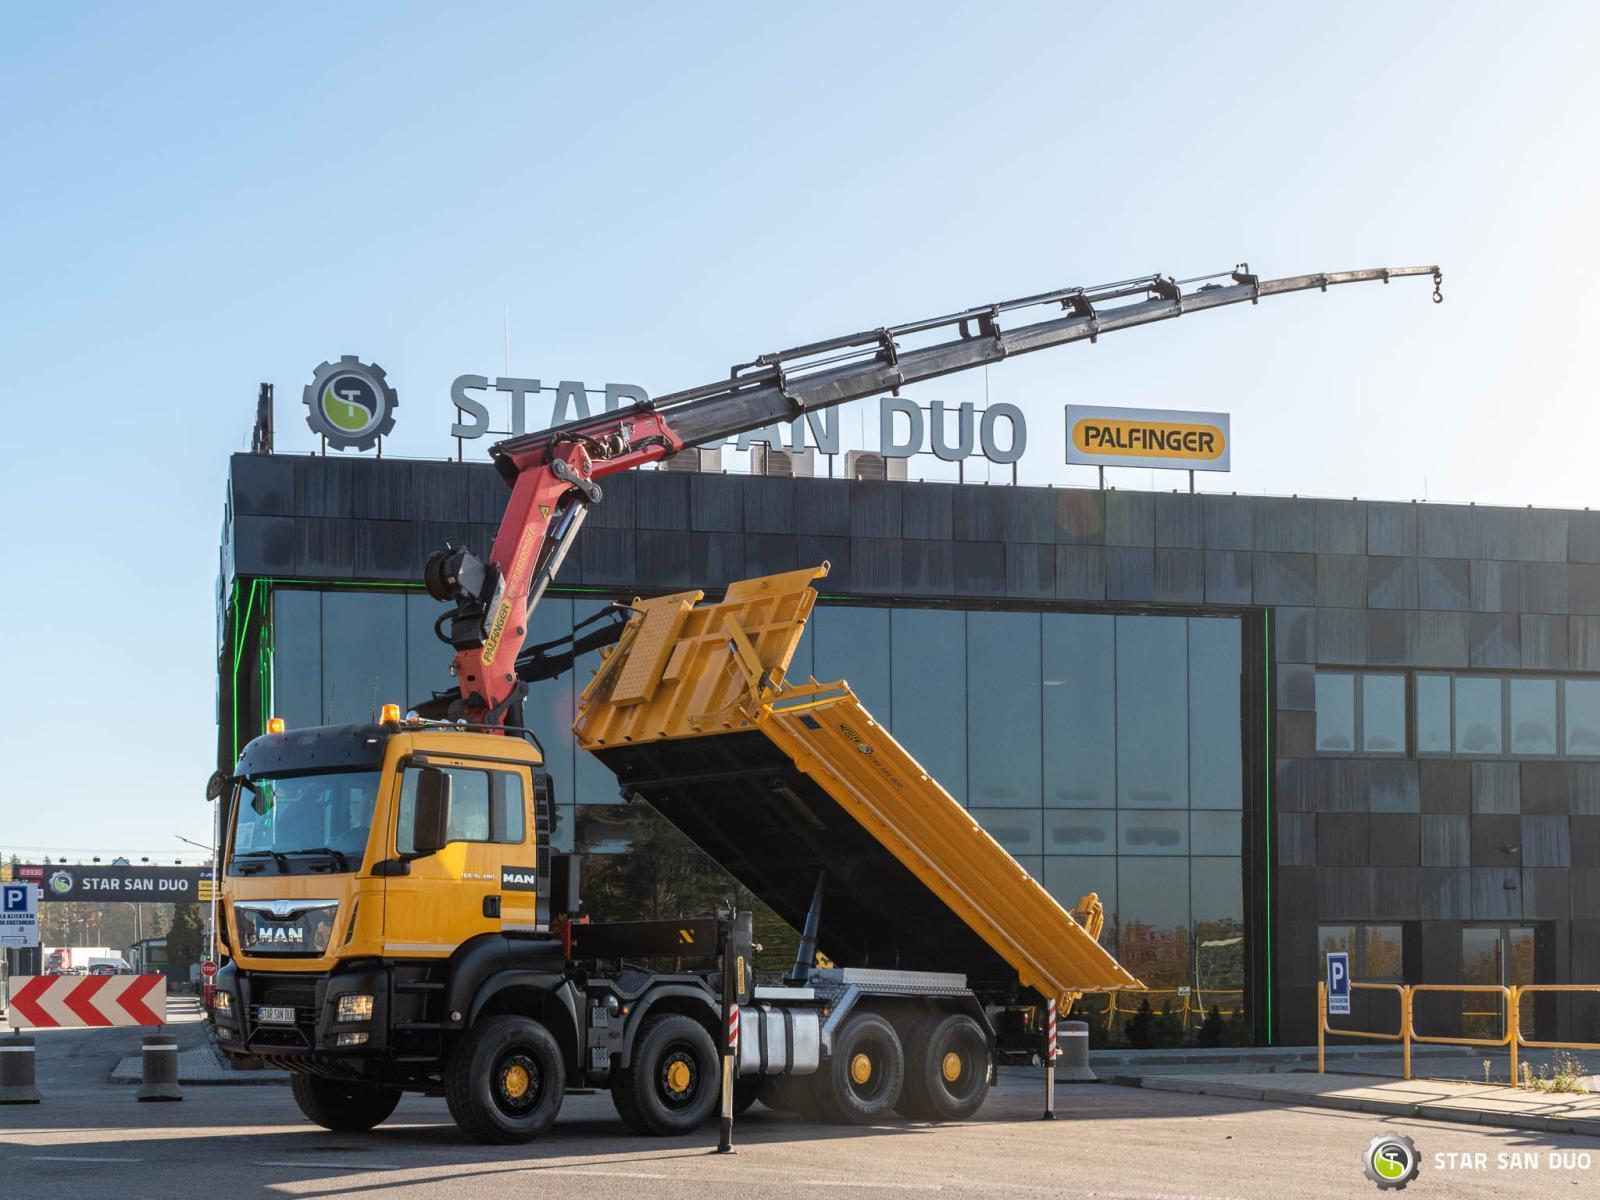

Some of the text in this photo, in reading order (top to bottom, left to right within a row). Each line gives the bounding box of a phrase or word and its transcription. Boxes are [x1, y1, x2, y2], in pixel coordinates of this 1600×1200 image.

[880, 397, 1027, 464] DUO
[1084, 425, 1214, 453] PALFINGER
[483, 603, 511, 662] PALFINGER
[82, 878, 120, 890] STAR
[124, 879, 153, 891] SAN
[158, 880, 188, 891] DUO
[503, 873, 535, 884] MAN
[8, 889, 23, 908] P
[258, 927, 304, 943] MAN
[1331, 961, 1344, 990] P
